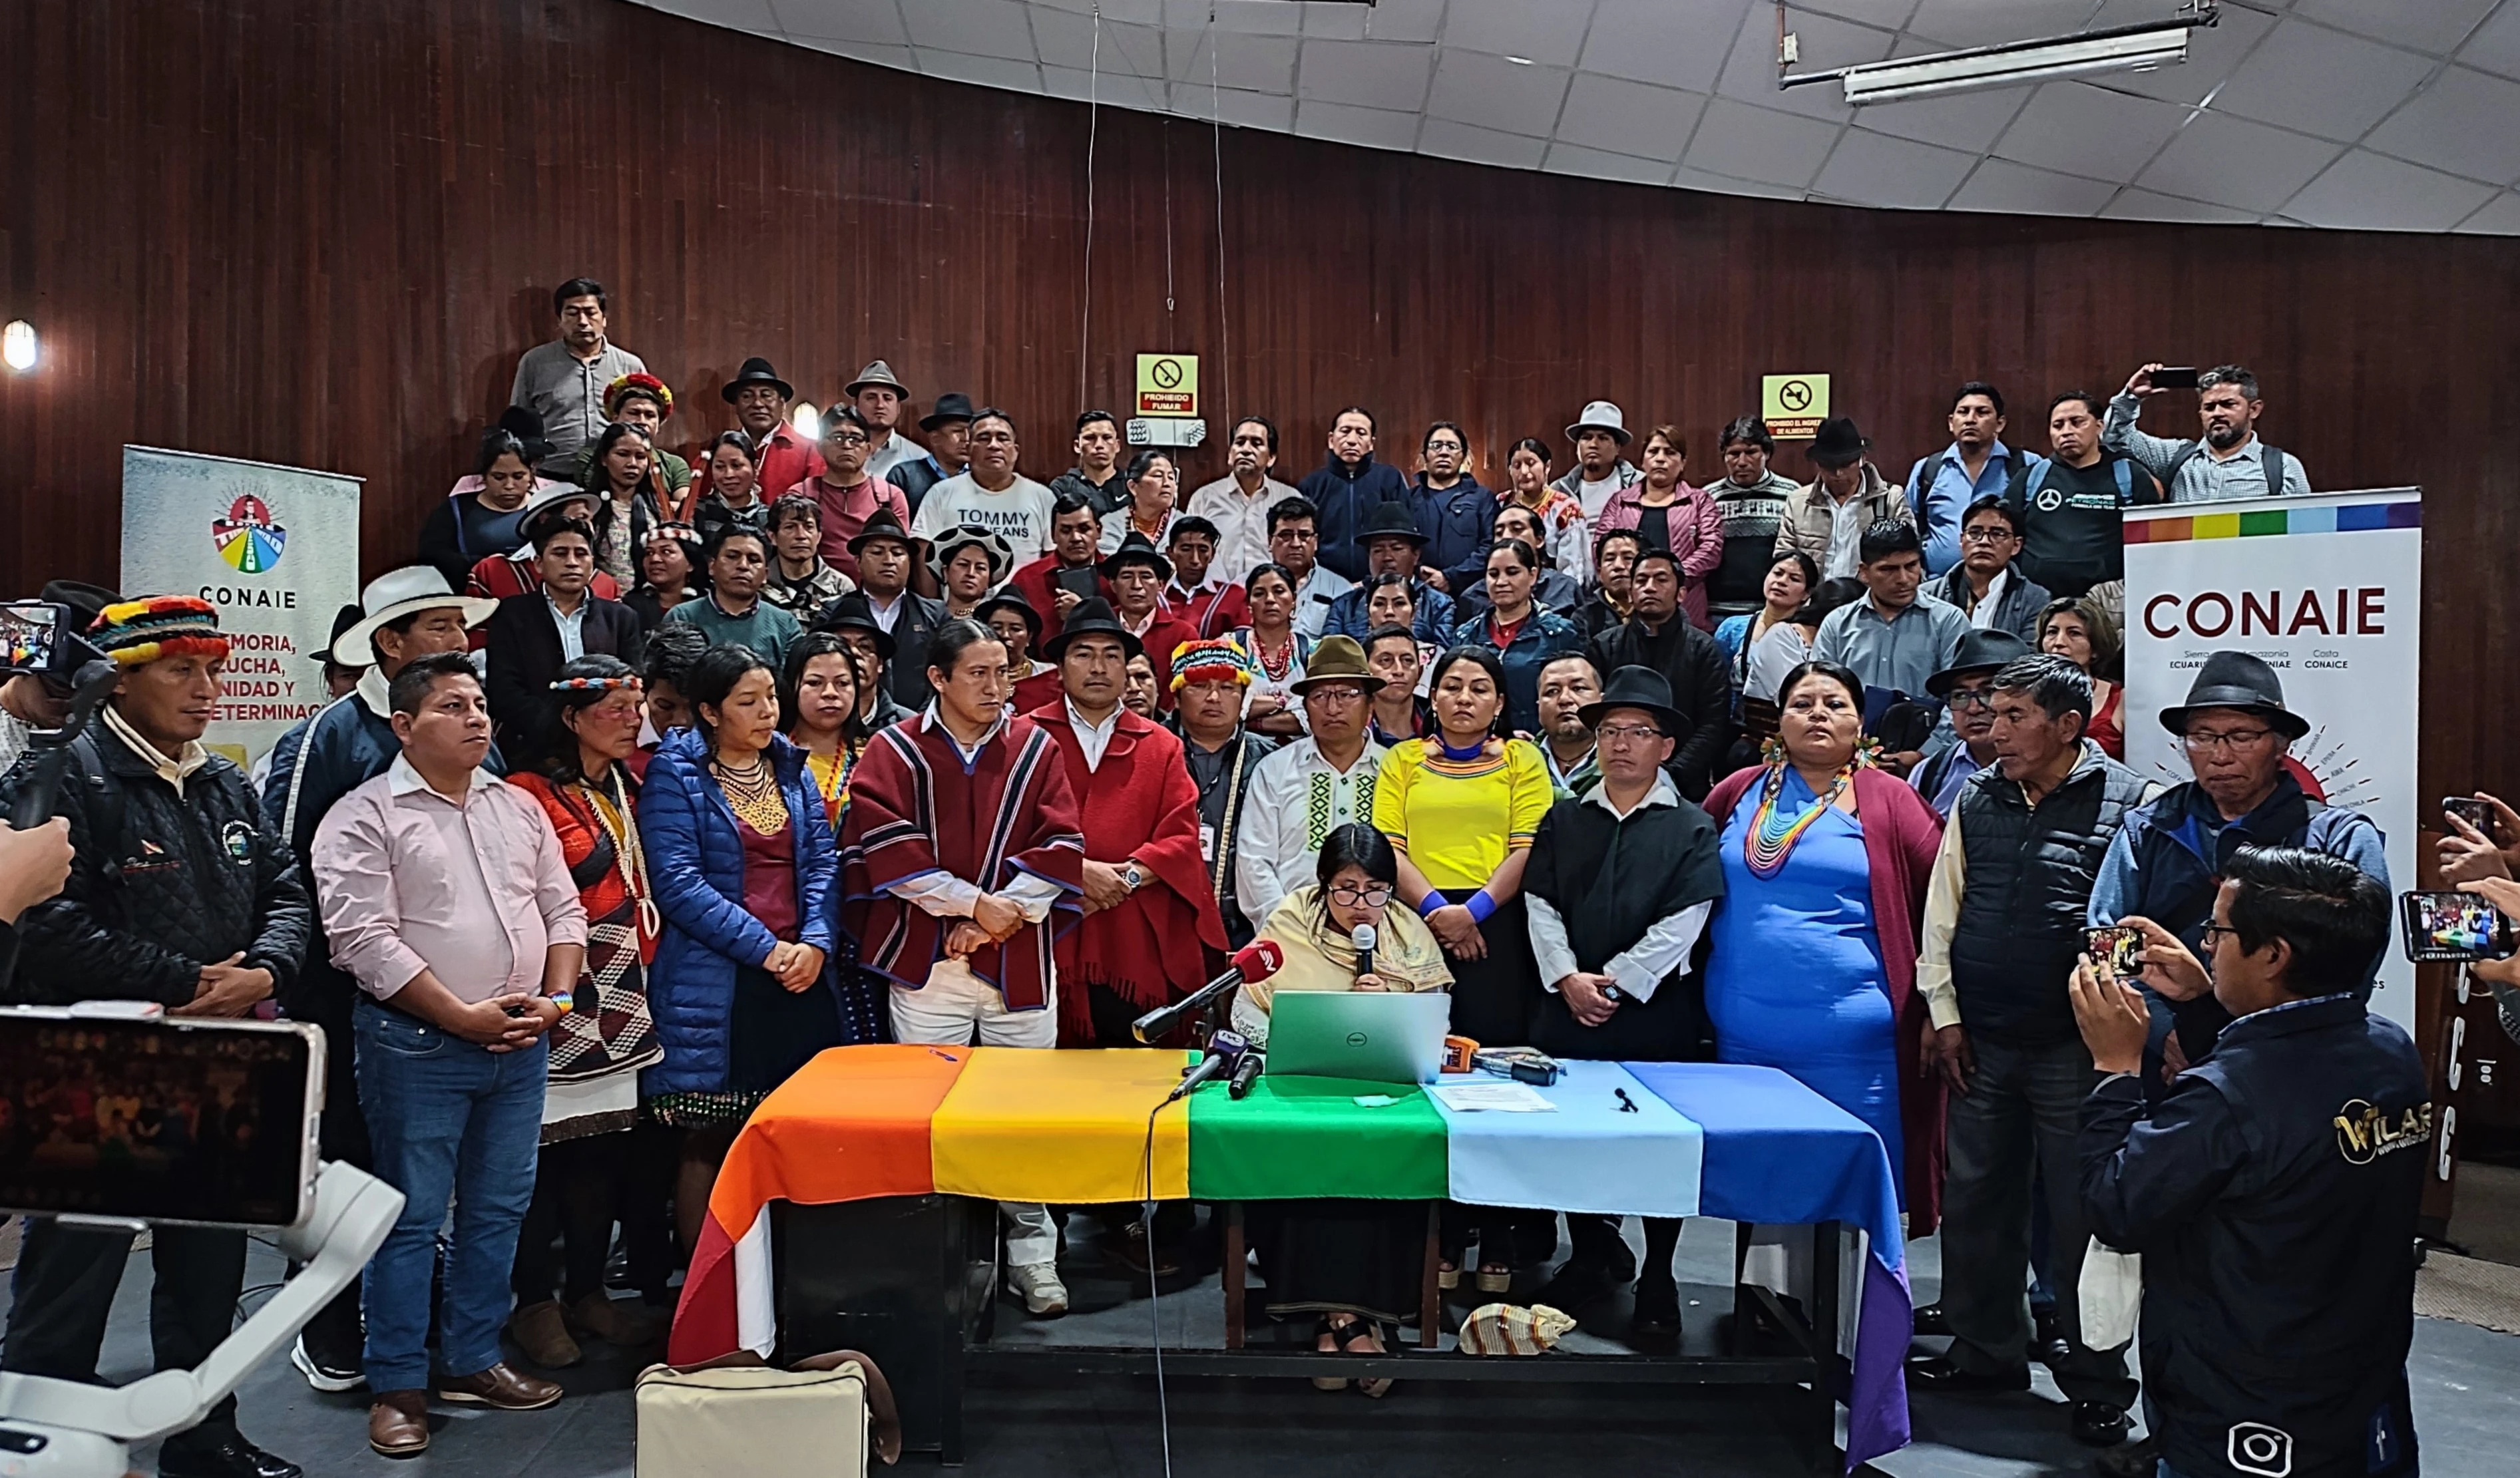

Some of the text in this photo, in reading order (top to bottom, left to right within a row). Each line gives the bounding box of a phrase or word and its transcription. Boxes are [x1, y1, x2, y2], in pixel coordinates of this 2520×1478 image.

[1144, 393, 1189, 402] PROHIBIDO
[957, 509, 1030, 526] TOMMY
[990, 526, 1029, 538] EANS
[200, 586, 296, 609] CONAIE
[2143, 587, 2386, 639] CONAIE
[227, 634, 297, 655] MORIA,
[2313, 649, 2339, 657] Costa
[2170, 660, 2206, 669] ECUARU
[2304, 660, 2348, 669] CONAICE
[220, 681, 296, 697] NIDAD Y
